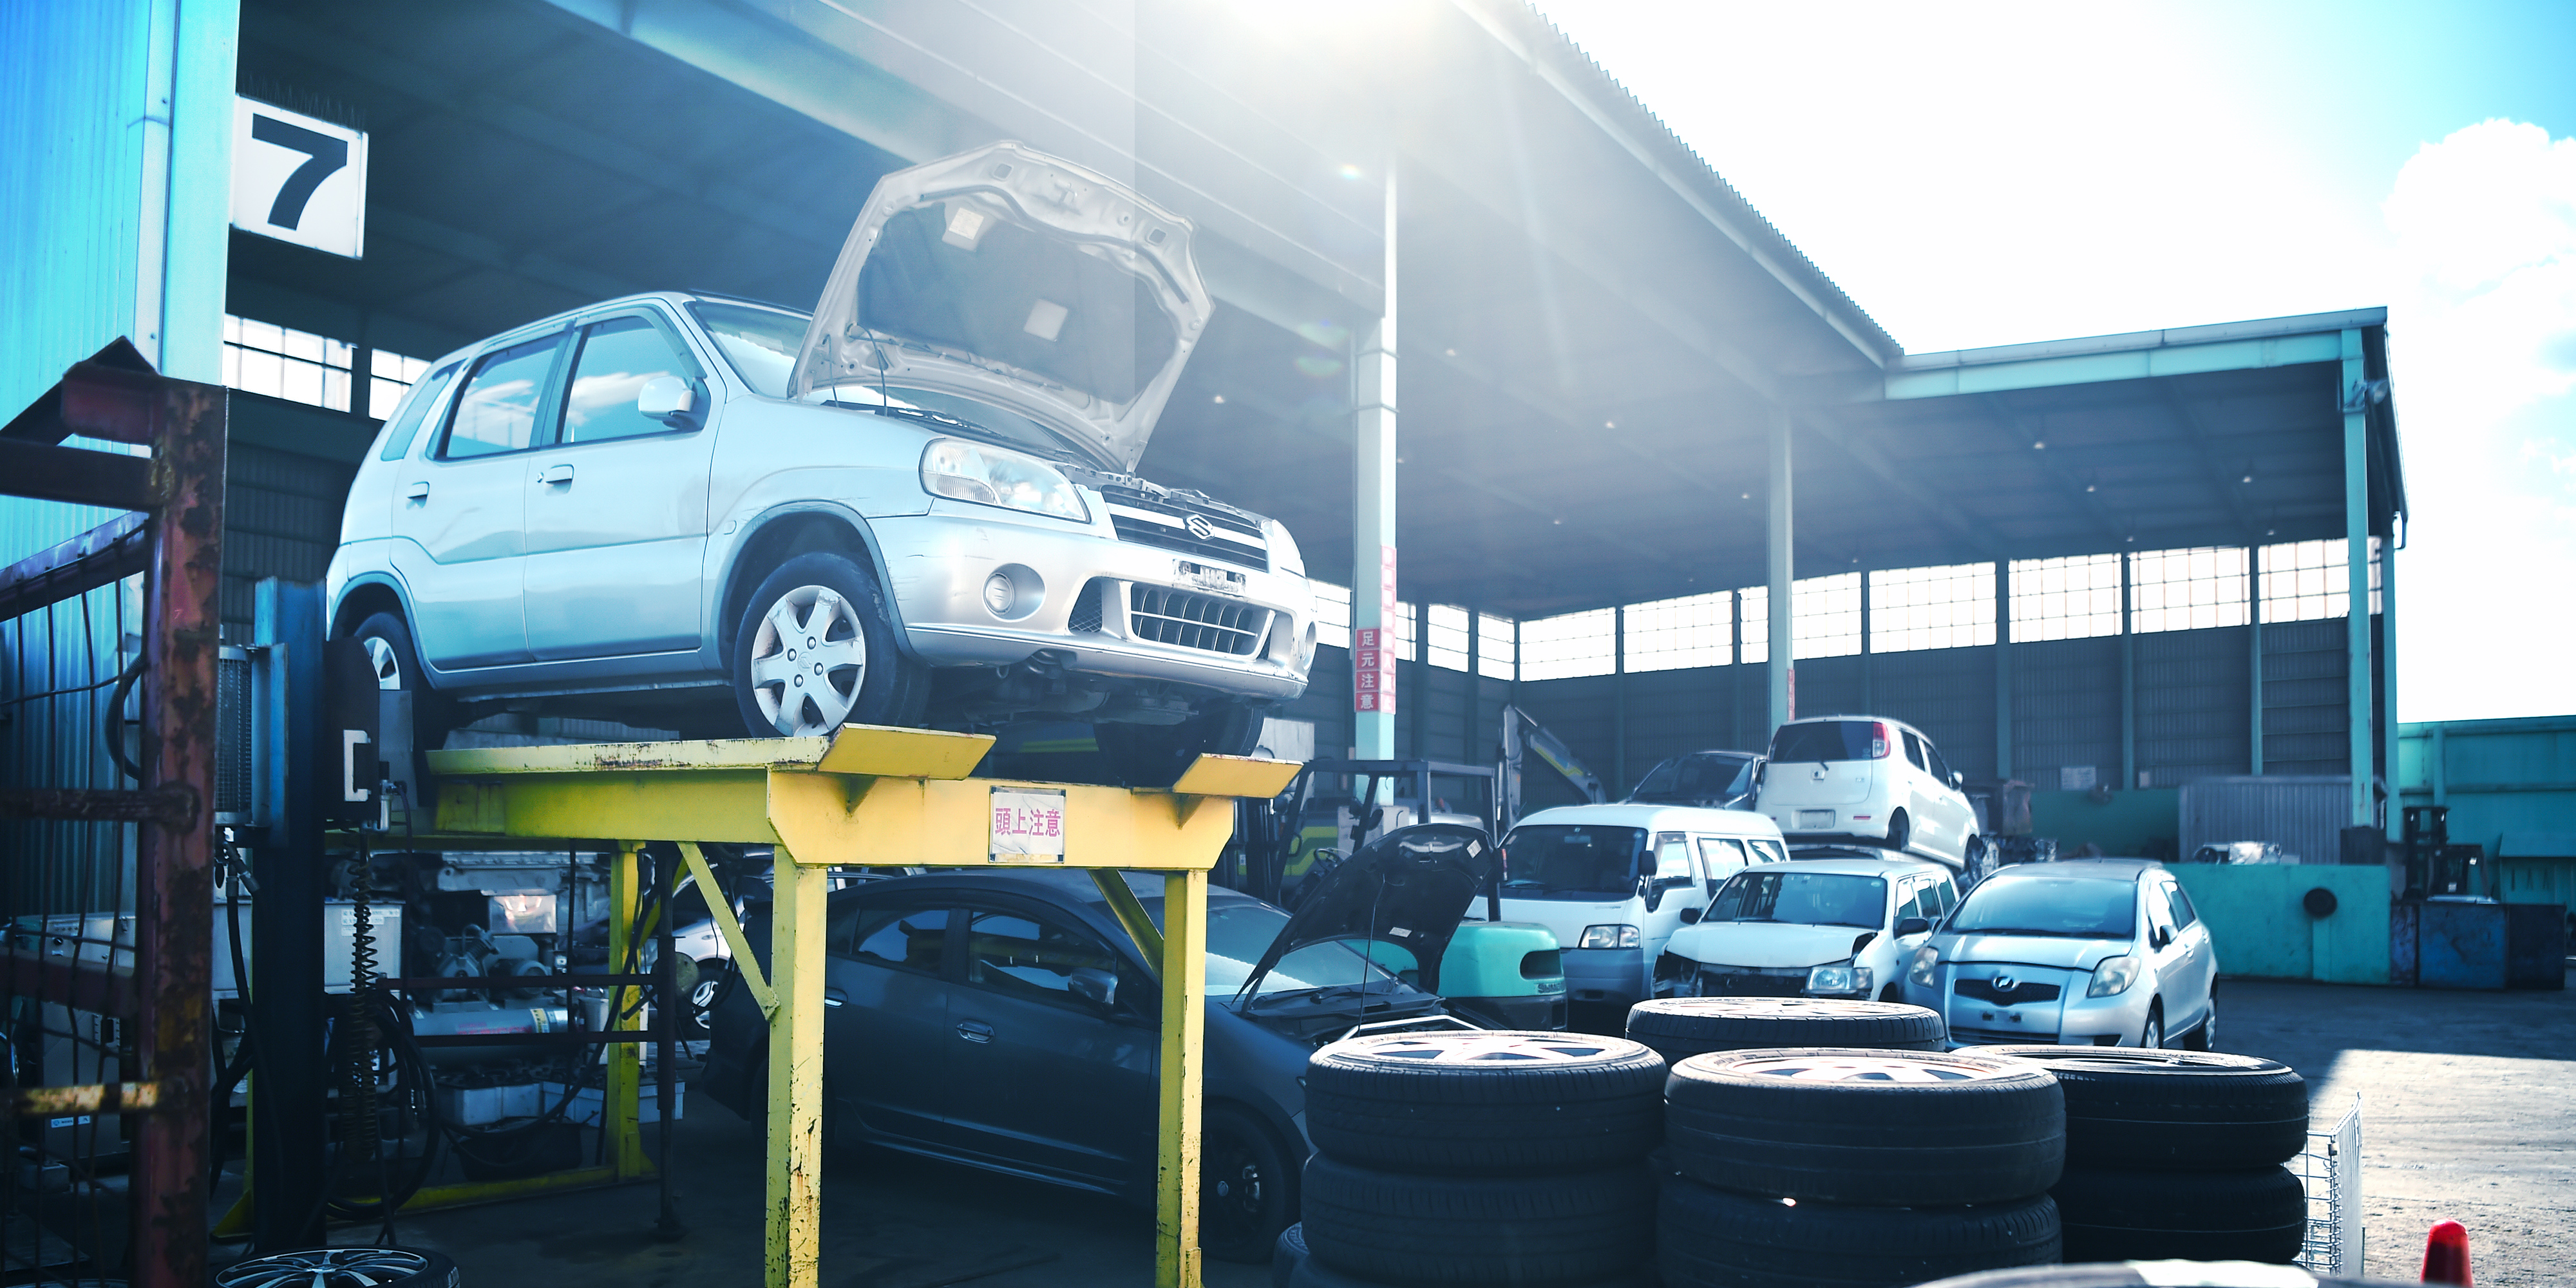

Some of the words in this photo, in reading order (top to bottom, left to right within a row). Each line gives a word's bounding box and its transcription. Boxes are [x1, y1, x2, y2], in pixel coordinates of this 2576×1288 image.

[252, 113, 347, 231] 7
[1361, 631, 1375, 710] 足元注意
[995, 808, 1061, 837] 頭上注意
